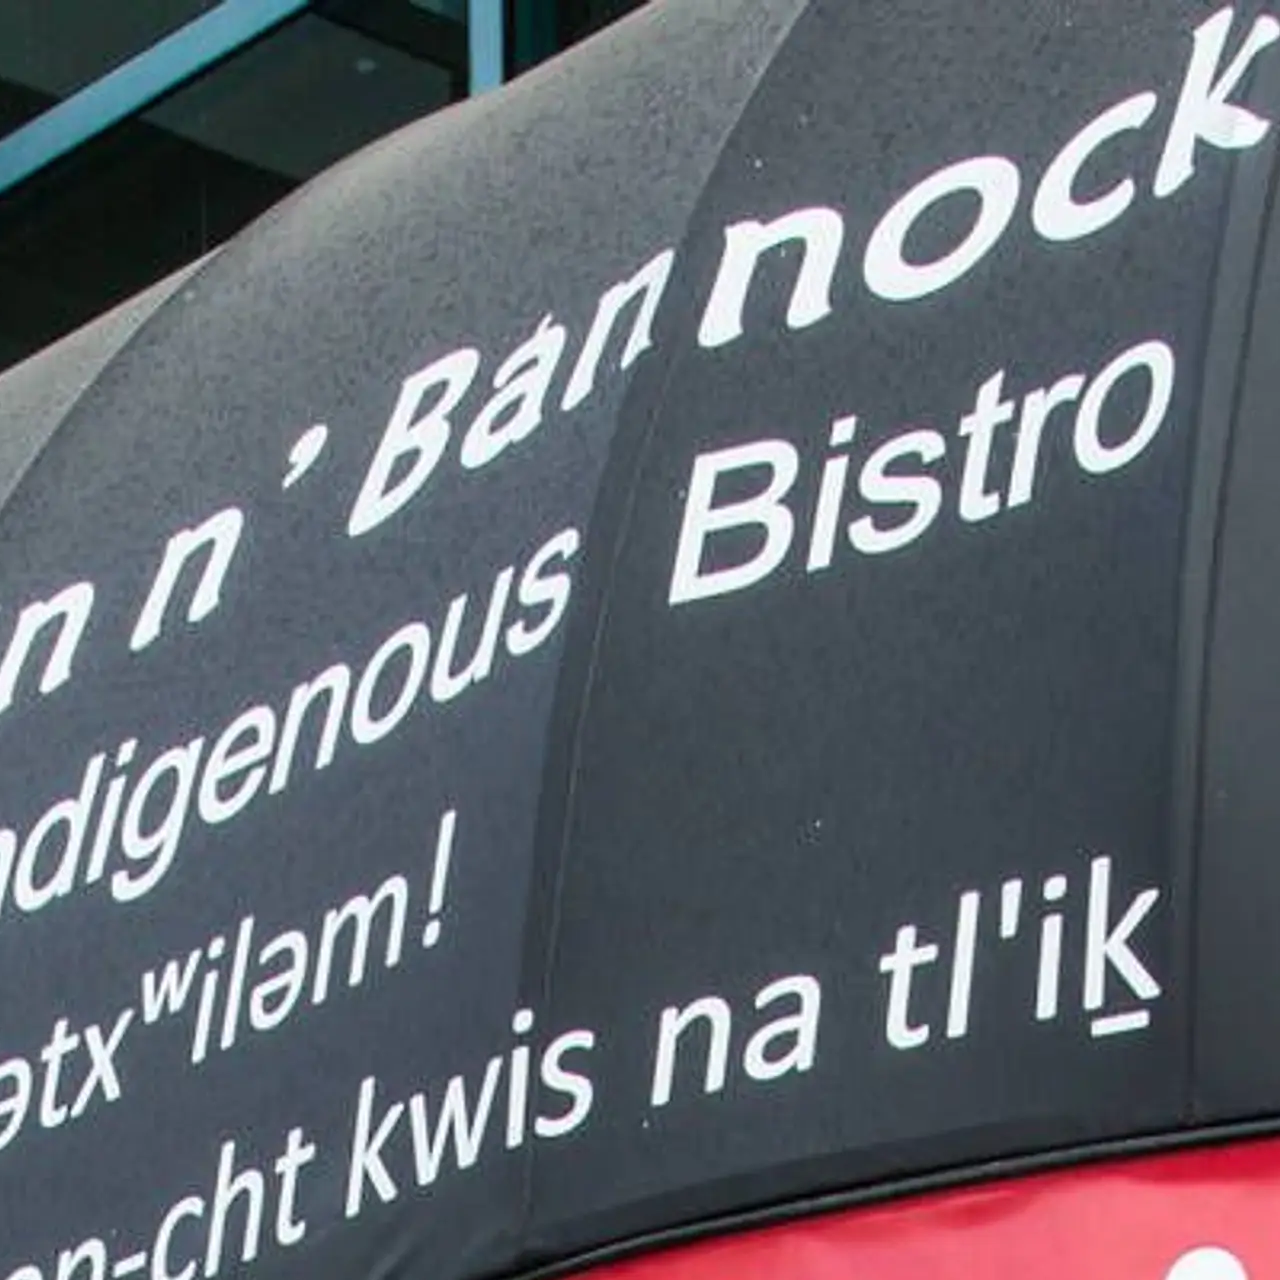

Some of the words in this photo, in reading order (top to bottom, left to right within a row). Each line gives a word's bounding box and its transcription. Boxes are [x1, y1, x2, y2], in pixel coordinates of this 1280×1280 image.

[348, 6, 1280, 537] Bannock
[669, 341, 1174, 604] Bistro
[346, 1010, 593, 1217] kwis
[652, 976, 820, 1105] na
